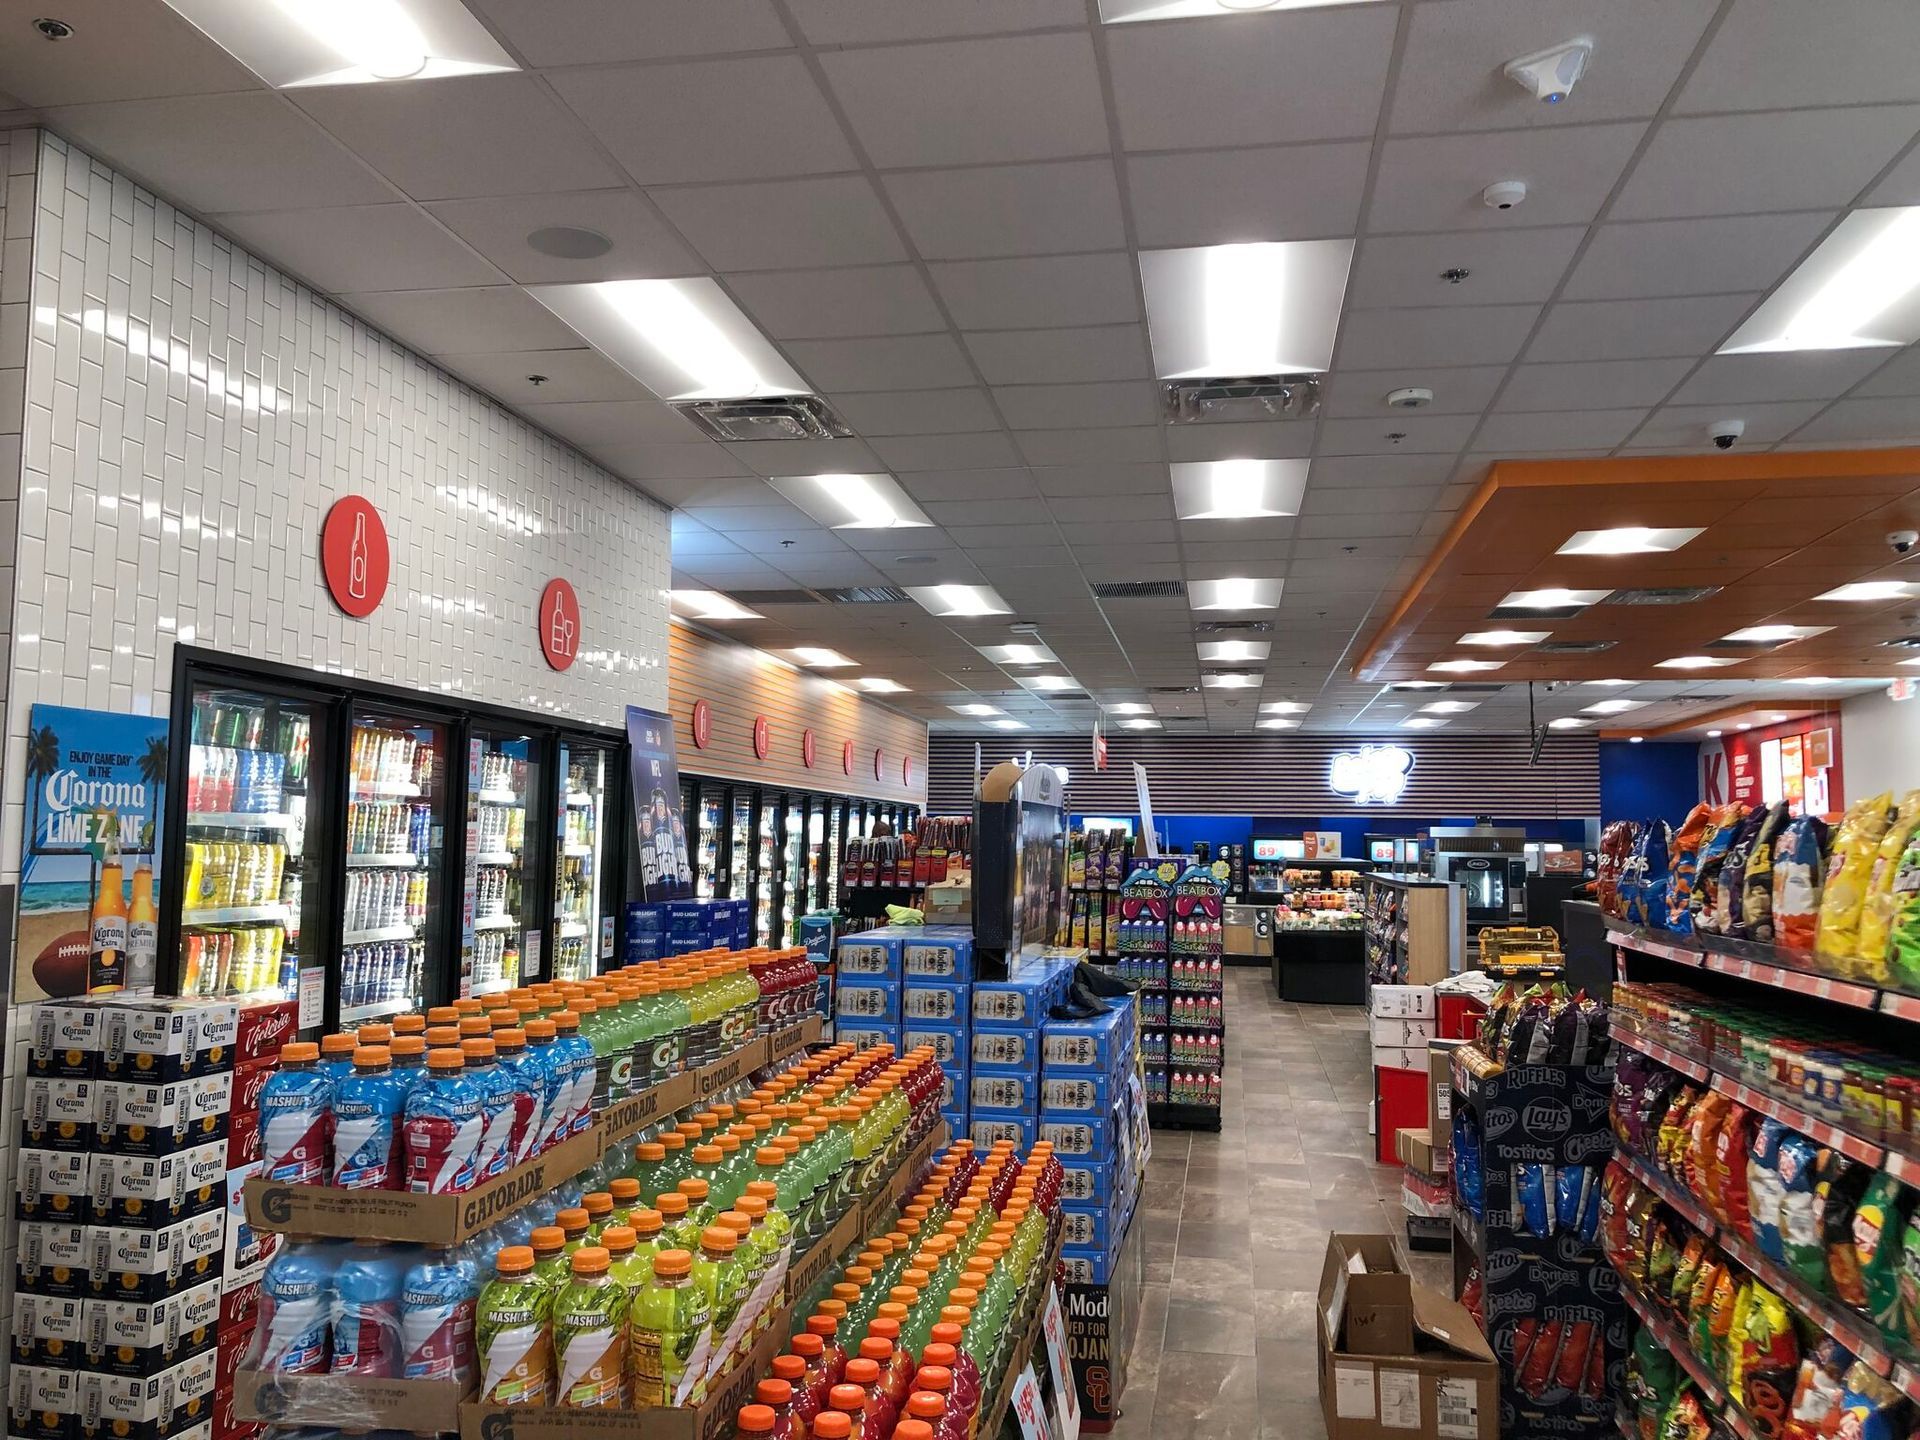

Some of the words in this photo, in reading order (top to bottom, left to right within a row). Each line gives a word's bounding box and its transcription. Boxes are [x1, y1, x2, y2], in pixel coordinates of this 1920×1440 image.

[69, 750, 92, 764] ENJOY
[94, 752, 116, 765] GAME
[88, 766, 97, 777] IN
[98, 766, 112, 778] THE
[46, 769, 146, 817] Corona
[46, 812, 93, 844] LIME
[1124, 888, 1168, 898] BEATBOX
[1177, 885, 1222, 896] BEATBOX
[62, 1025, 90, 1036] Corona
[133, 1029, 162, 1040] Corona
[202, 1021, 233, 1037] Corona
[1506, 1068, 1566, 1089] RUFFLES
[56, 1097, 84, 1108] Corona
[195, 1090, 226, 1107] Corona
[125, 1102, 153, 1113] Corona
[191, 1159, 222, 1177] Corona
[49, 1170, 77, 1180] Corona
[121, 1175, 150, 1186] Corona
[464, 1166, 545, 1230] GATORADE
[189, 1229, 219, 1248] Corona
[49, 1242, 78, 1252] Corona
[118, 1248, 147, 1258] Corona
[185, 1299, 215, 1320] Corona
[42, 1316, 70, 1327] Corona
[114, 1321, 143, 1331] Corona
[1088, 1322, 1106, 1336] FOR
[180, 1369, 210, 1392] Corona
[39, 1387, 65, 1399] Corona
[109, 1395, 137, 1407] Corona
